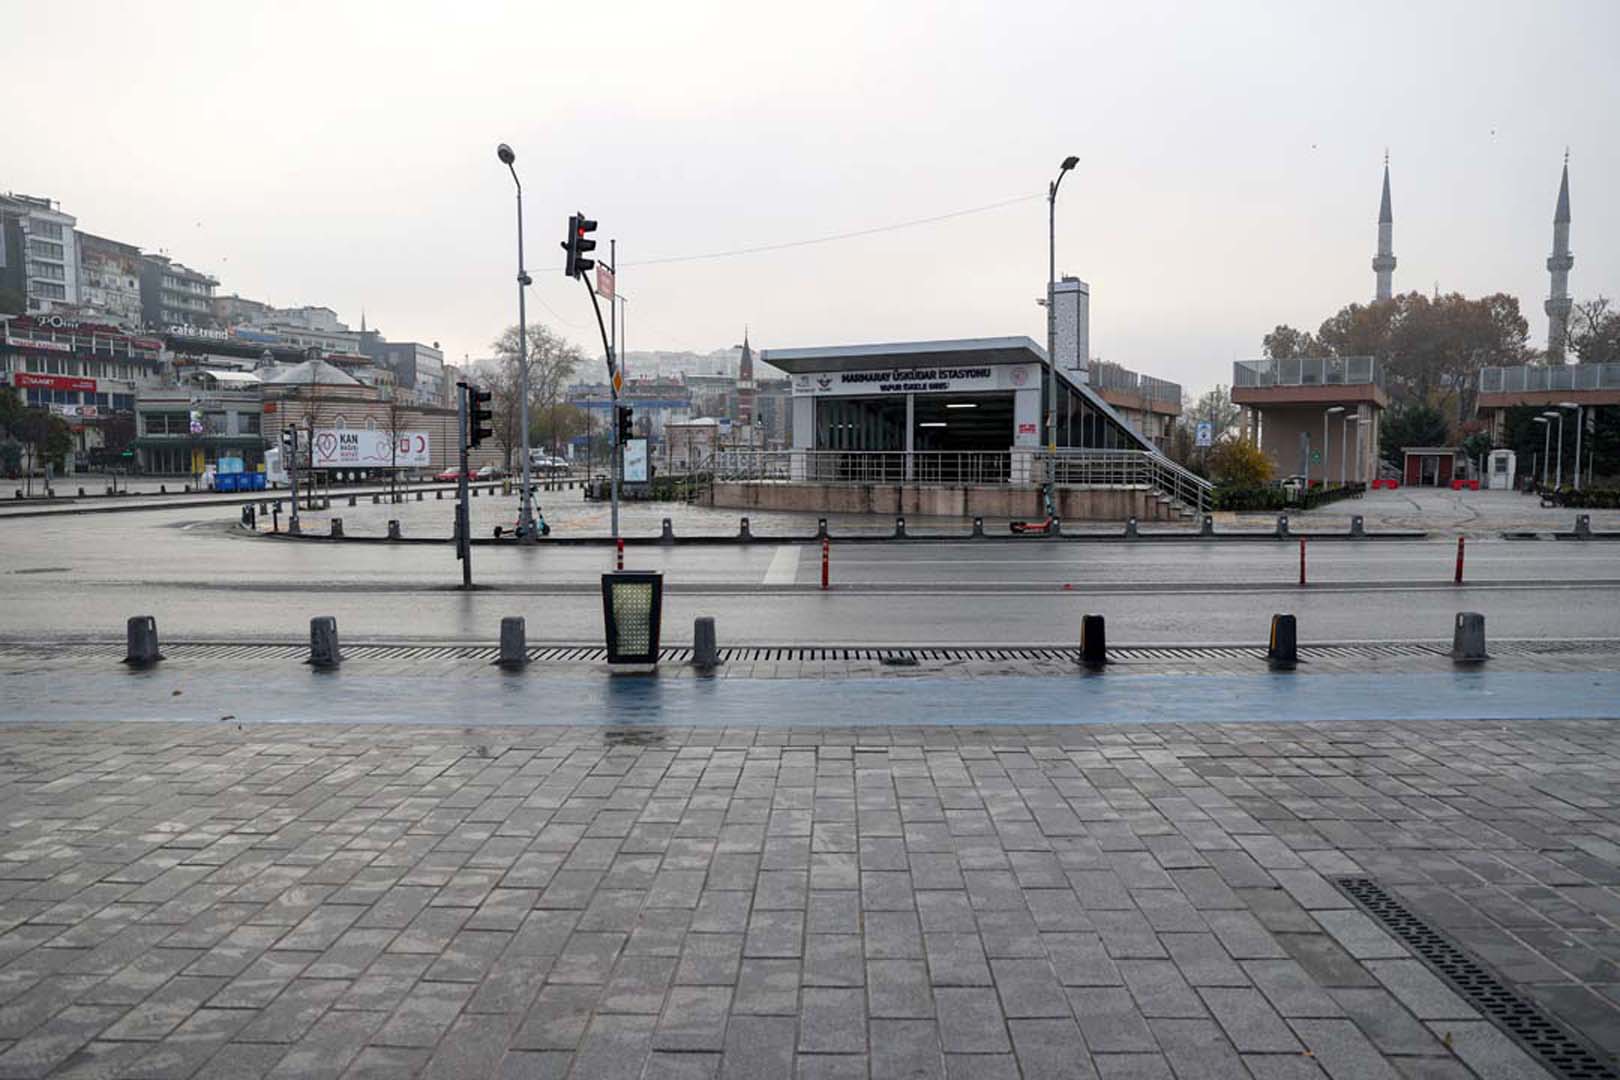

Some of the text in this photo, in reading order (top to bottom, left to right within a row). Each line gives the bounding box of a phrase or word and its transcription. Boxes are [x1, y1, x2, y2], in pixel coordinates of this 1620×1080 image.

[200, 327, 229, 341] trend
[841, 372, 891, 383] MARMARAY
[892, 368, 938, 381] ÜSKÜDAR
[340, 433, 359, 444] KAN
